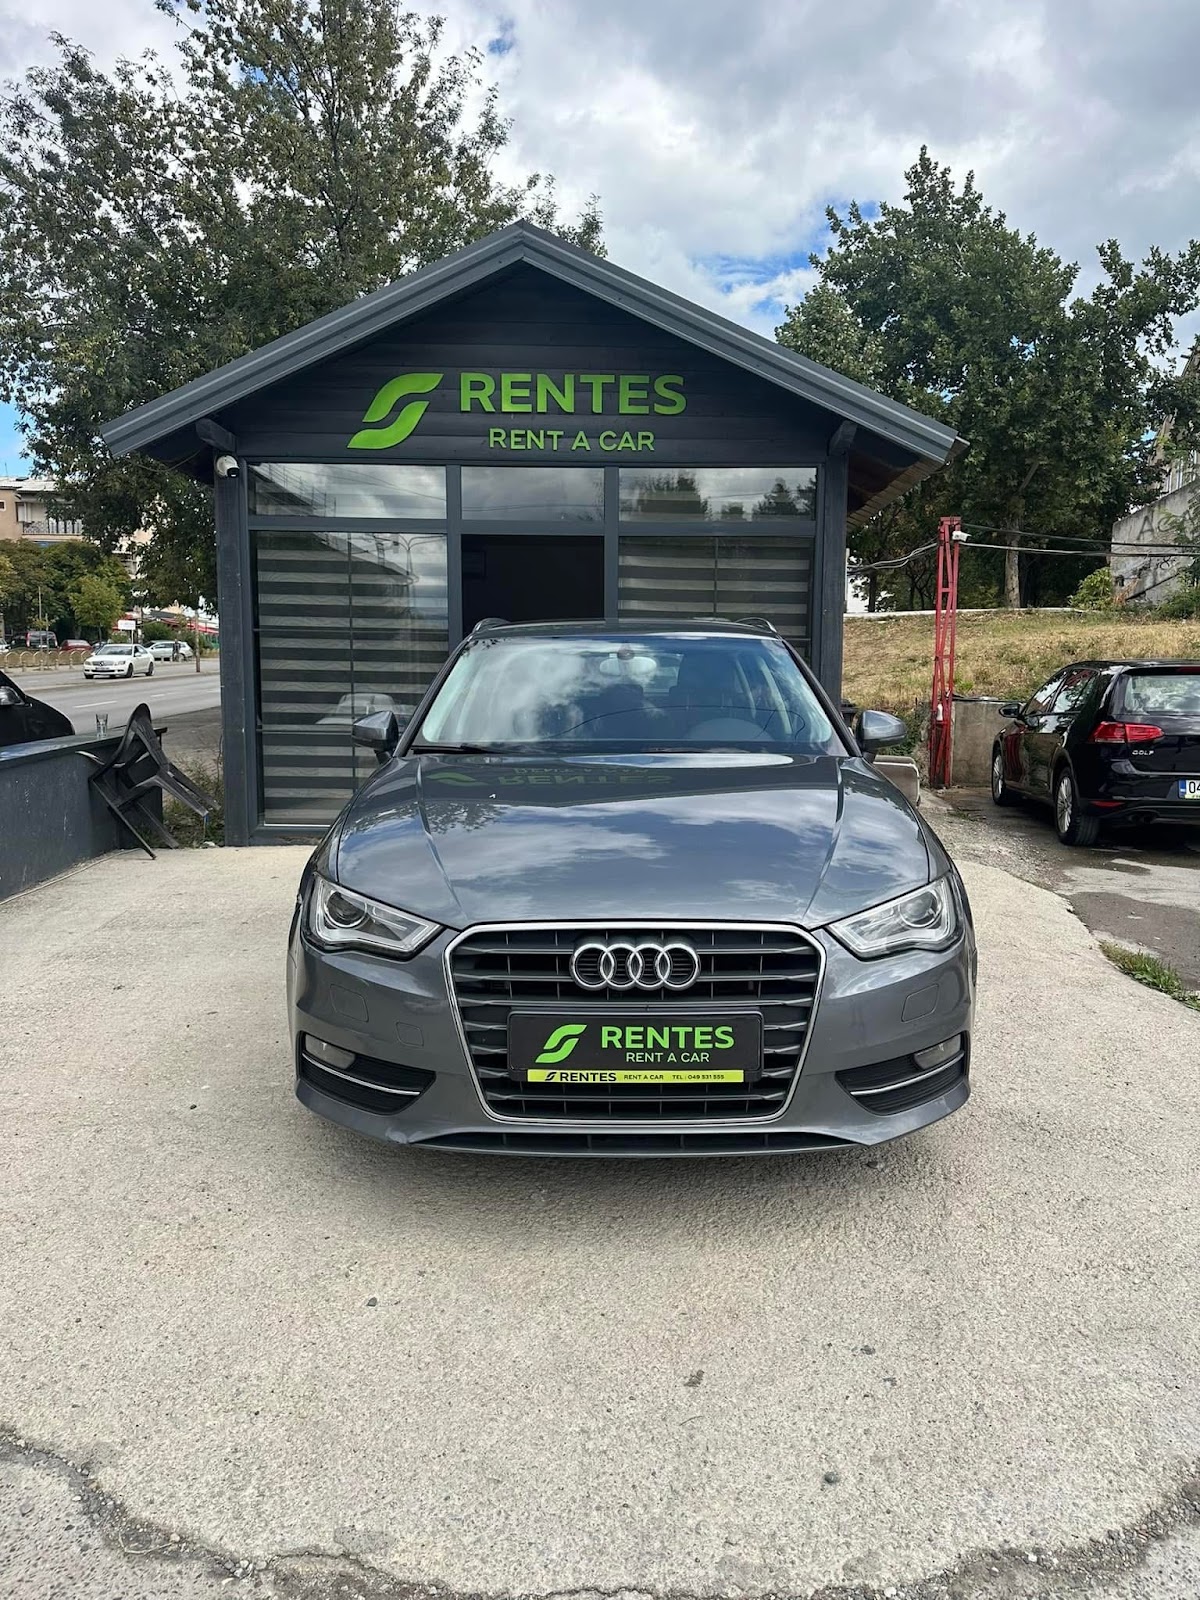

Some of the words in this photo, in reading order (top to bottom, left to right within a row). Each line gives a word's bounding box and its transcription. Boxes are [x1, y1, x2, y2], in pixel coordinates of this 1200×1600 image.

[459, 371, 688, 416] RENTES
[488, 427, 564, 451] RENT
[571, 430, 592, 451] A
[599, 430, 656, 451] CAR
[601, 1025, 735, 1050] RENTES
[625, 1052, 663, 1063] RENT
[667, 1052, 677, 1063] A
[680, 1052, 710, 1063] CAR
[559, 1072, 617, 1082] RENTES
